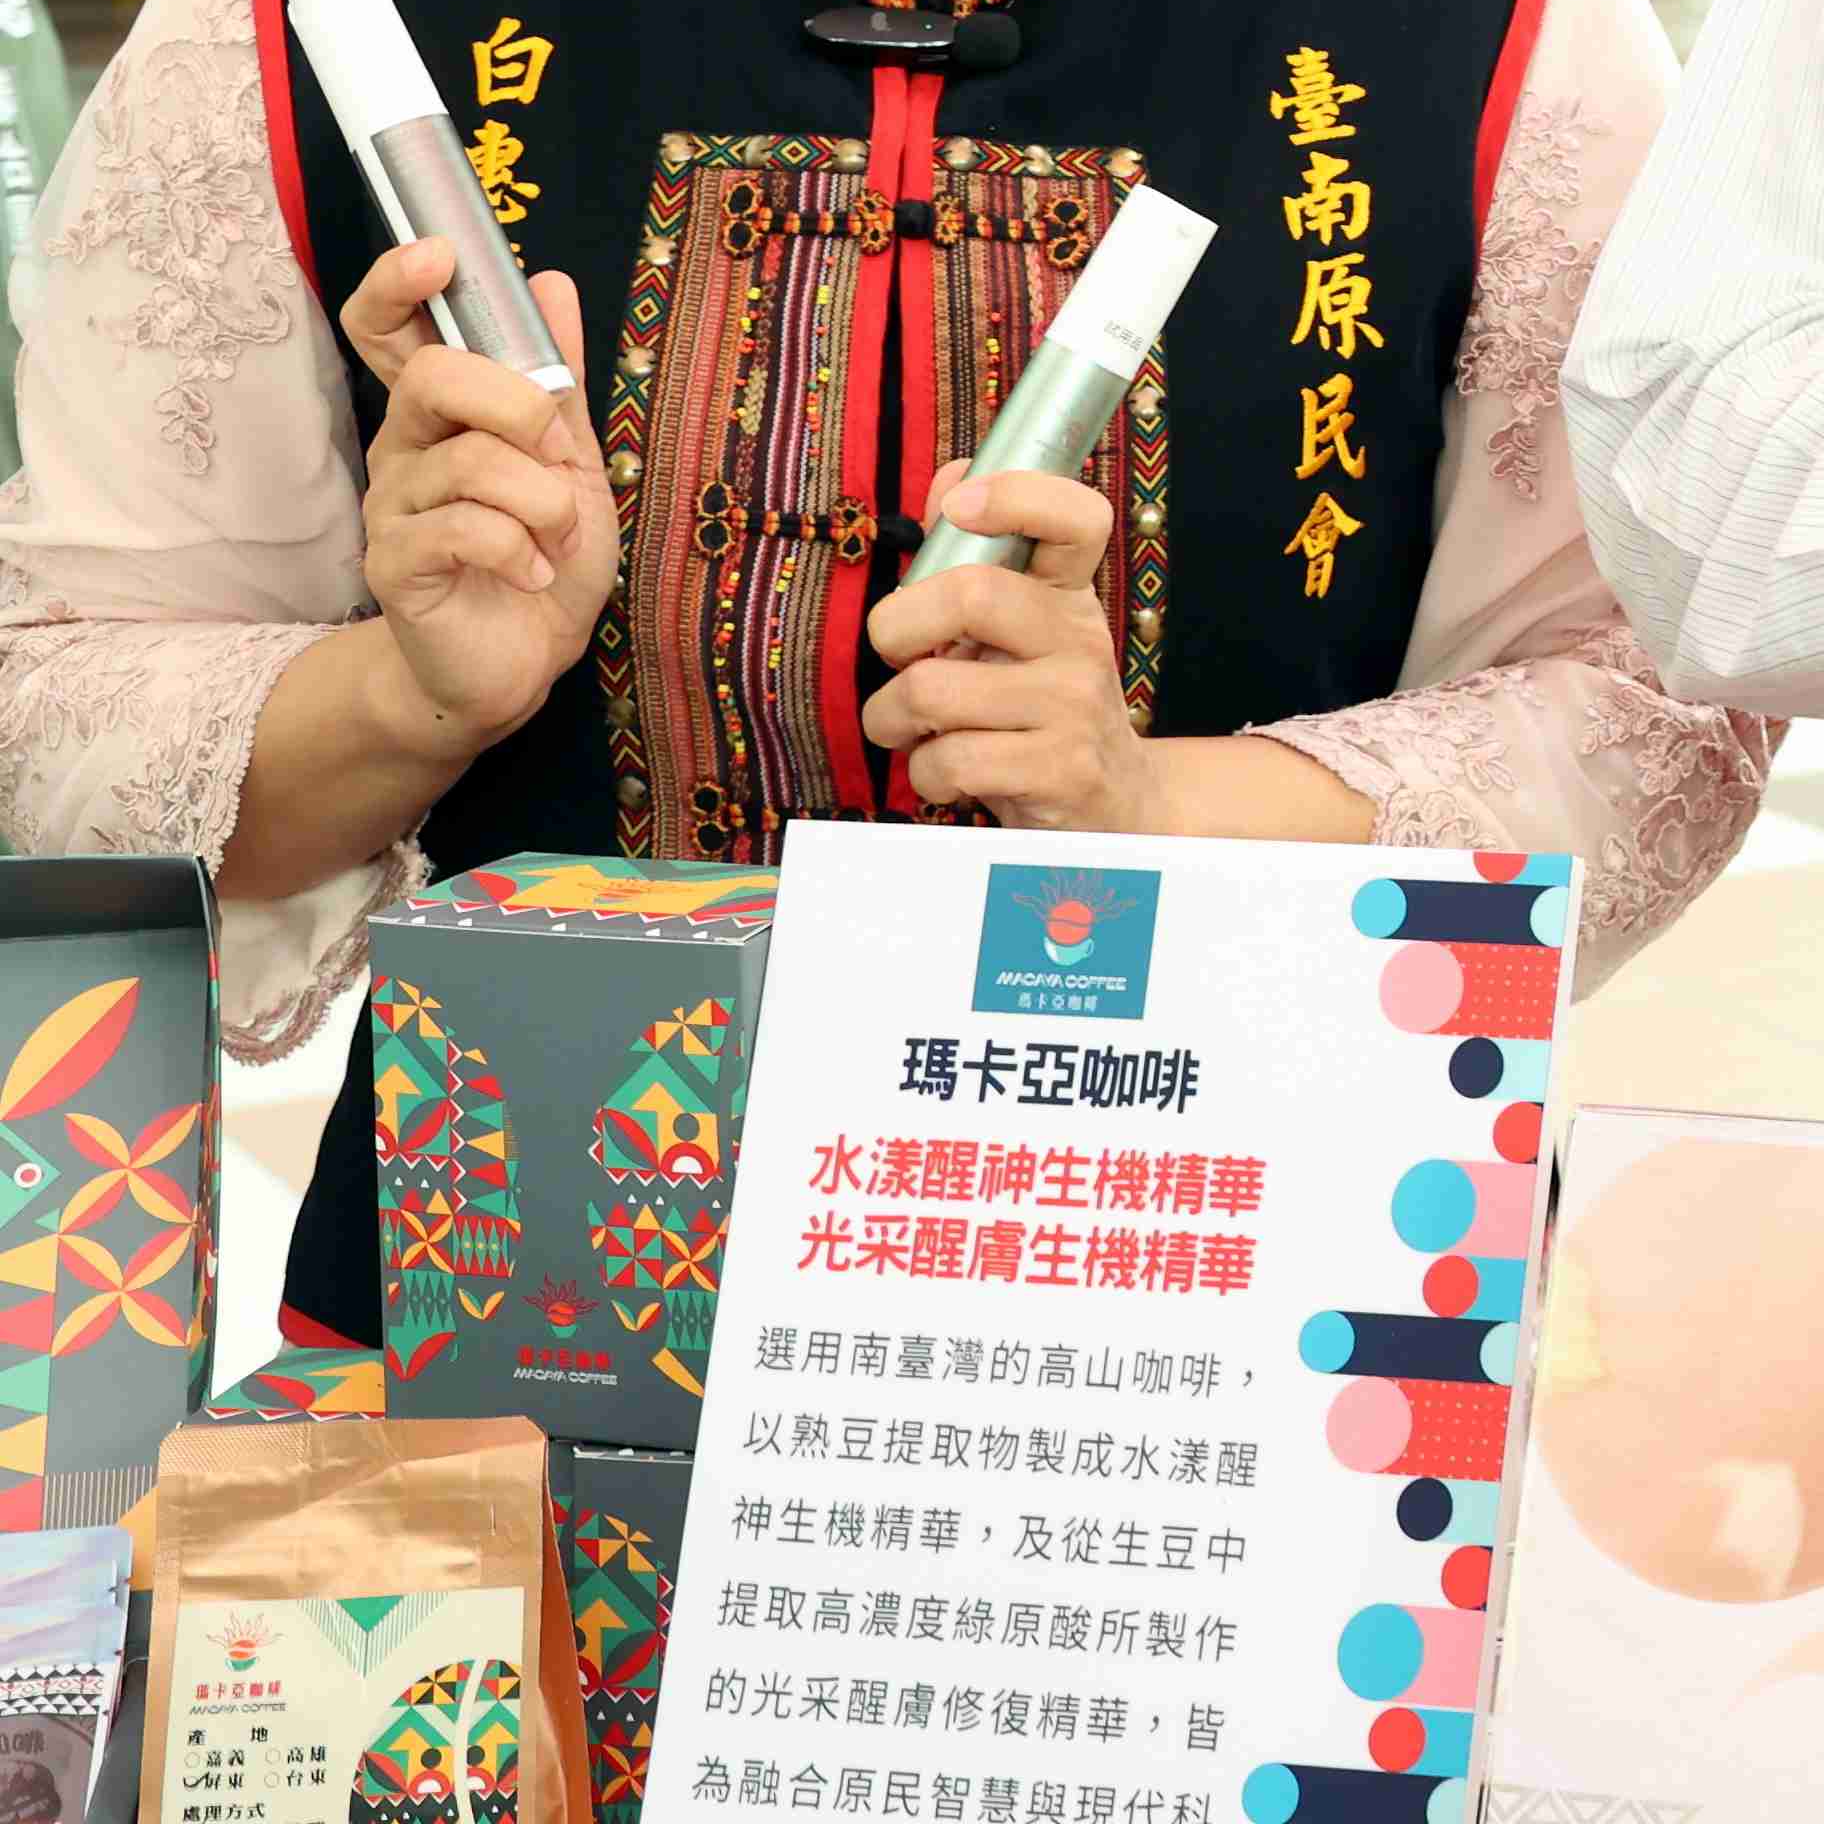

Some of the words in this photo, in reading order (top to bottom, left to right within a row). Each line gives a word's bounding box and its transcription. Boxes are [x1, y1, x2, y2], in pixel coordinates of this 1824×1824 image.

[464, 16, 554, 270] 白惠
[1269, 44, 1384, 600] 臺南原民會
[896, 1037, 1200, 1114] 瑪卡亞咖啡
[809, 1133, 1267, 1219] 水漾醒神生機精華
[799, 1212, 1258, 1297] 光采醒膚生機精華
[754, 1325, 1256, 1400] 選用南臺灣的高山咖啡，
[742, 1413, 1259, 1489] 以熟豆提取物製成水漾醒
[731, 1496, 1249, 1576] 神生機精華，及從生豆中
[717, 1581, 1239, 1664] 提取高濃度綠原酸所製作
[187, 1728, 207, 1746] 產
[250, 1725, 268, 1743] 地
[705, 1668, 1227, 1753] 的光采醒膚修復精華，皆
